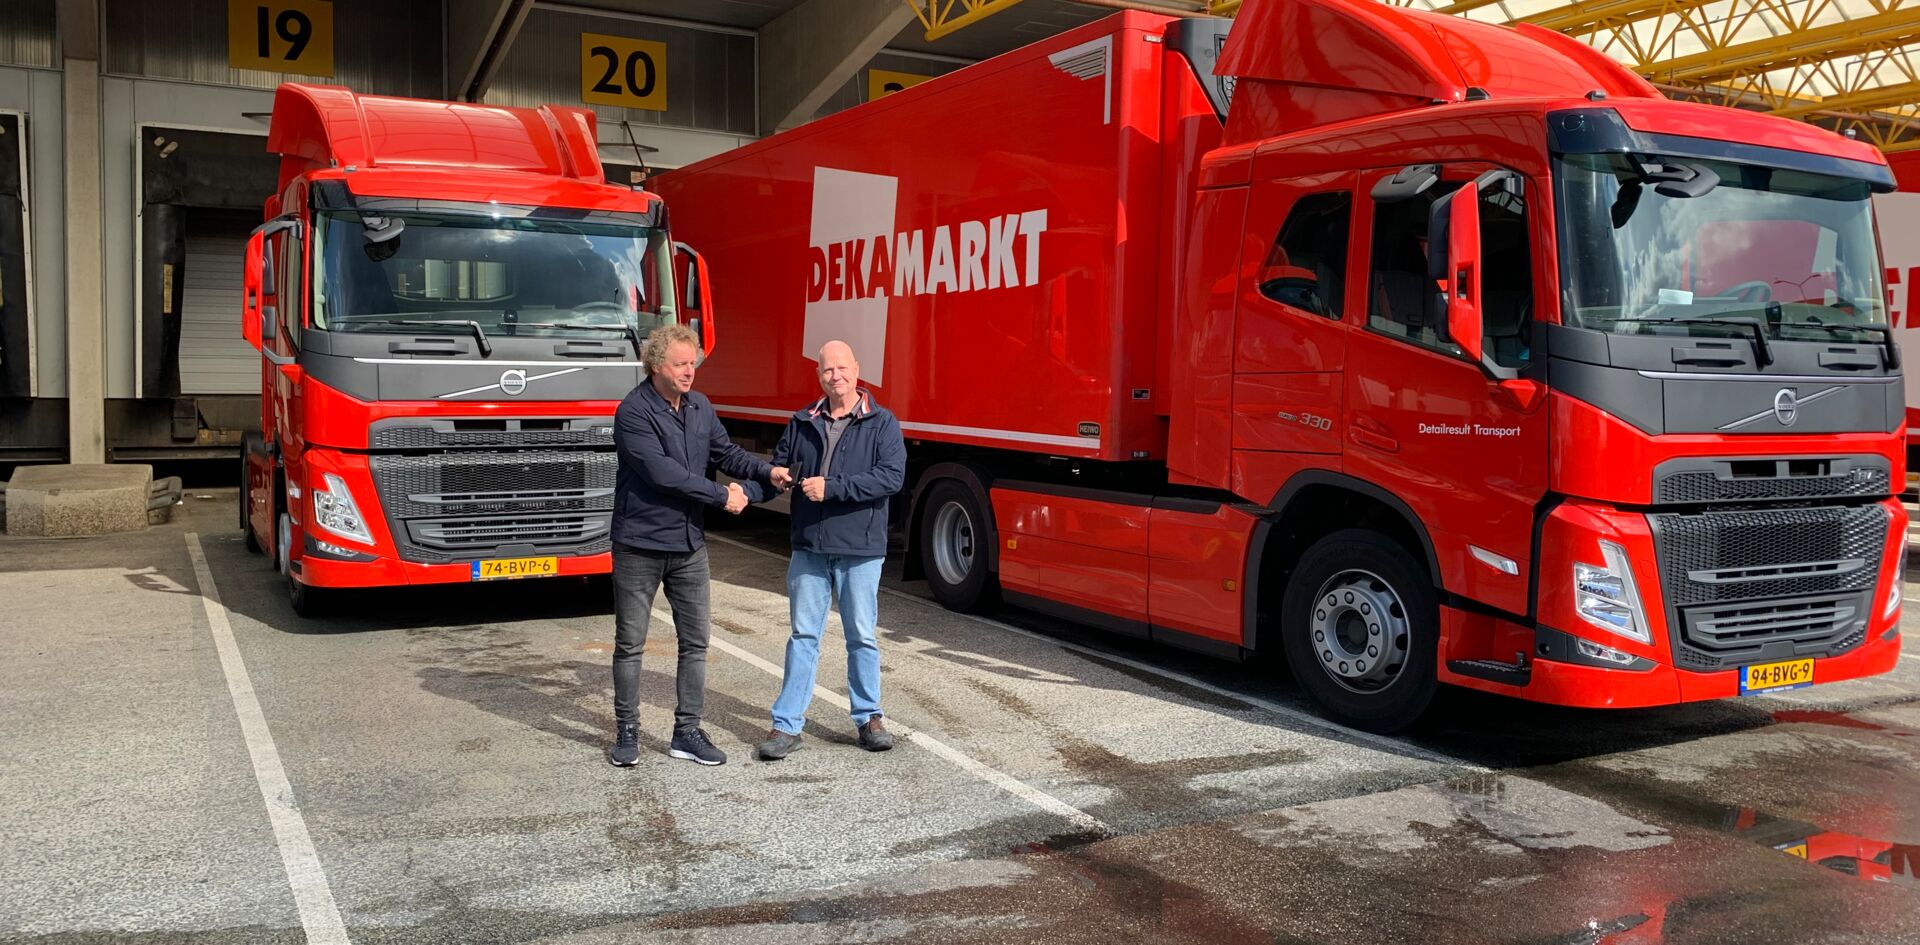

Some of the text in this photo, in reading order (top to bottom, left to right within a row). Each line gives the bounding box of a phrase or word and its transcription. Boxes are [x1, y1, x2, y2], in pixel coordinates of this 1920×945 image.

[257, 6, 312, 61] 19
[591, 46, 656, 97] 20
[806, 208, 1048, 303] DEKAMARKT
[1299, 412, 1332, 431] 330
[1419, 423, 1520, 438] Detailresult Transport
[485, 560, 551, 575] 74-BVP-6
[1752, 662, 1810, 686] 94-BVG-9
